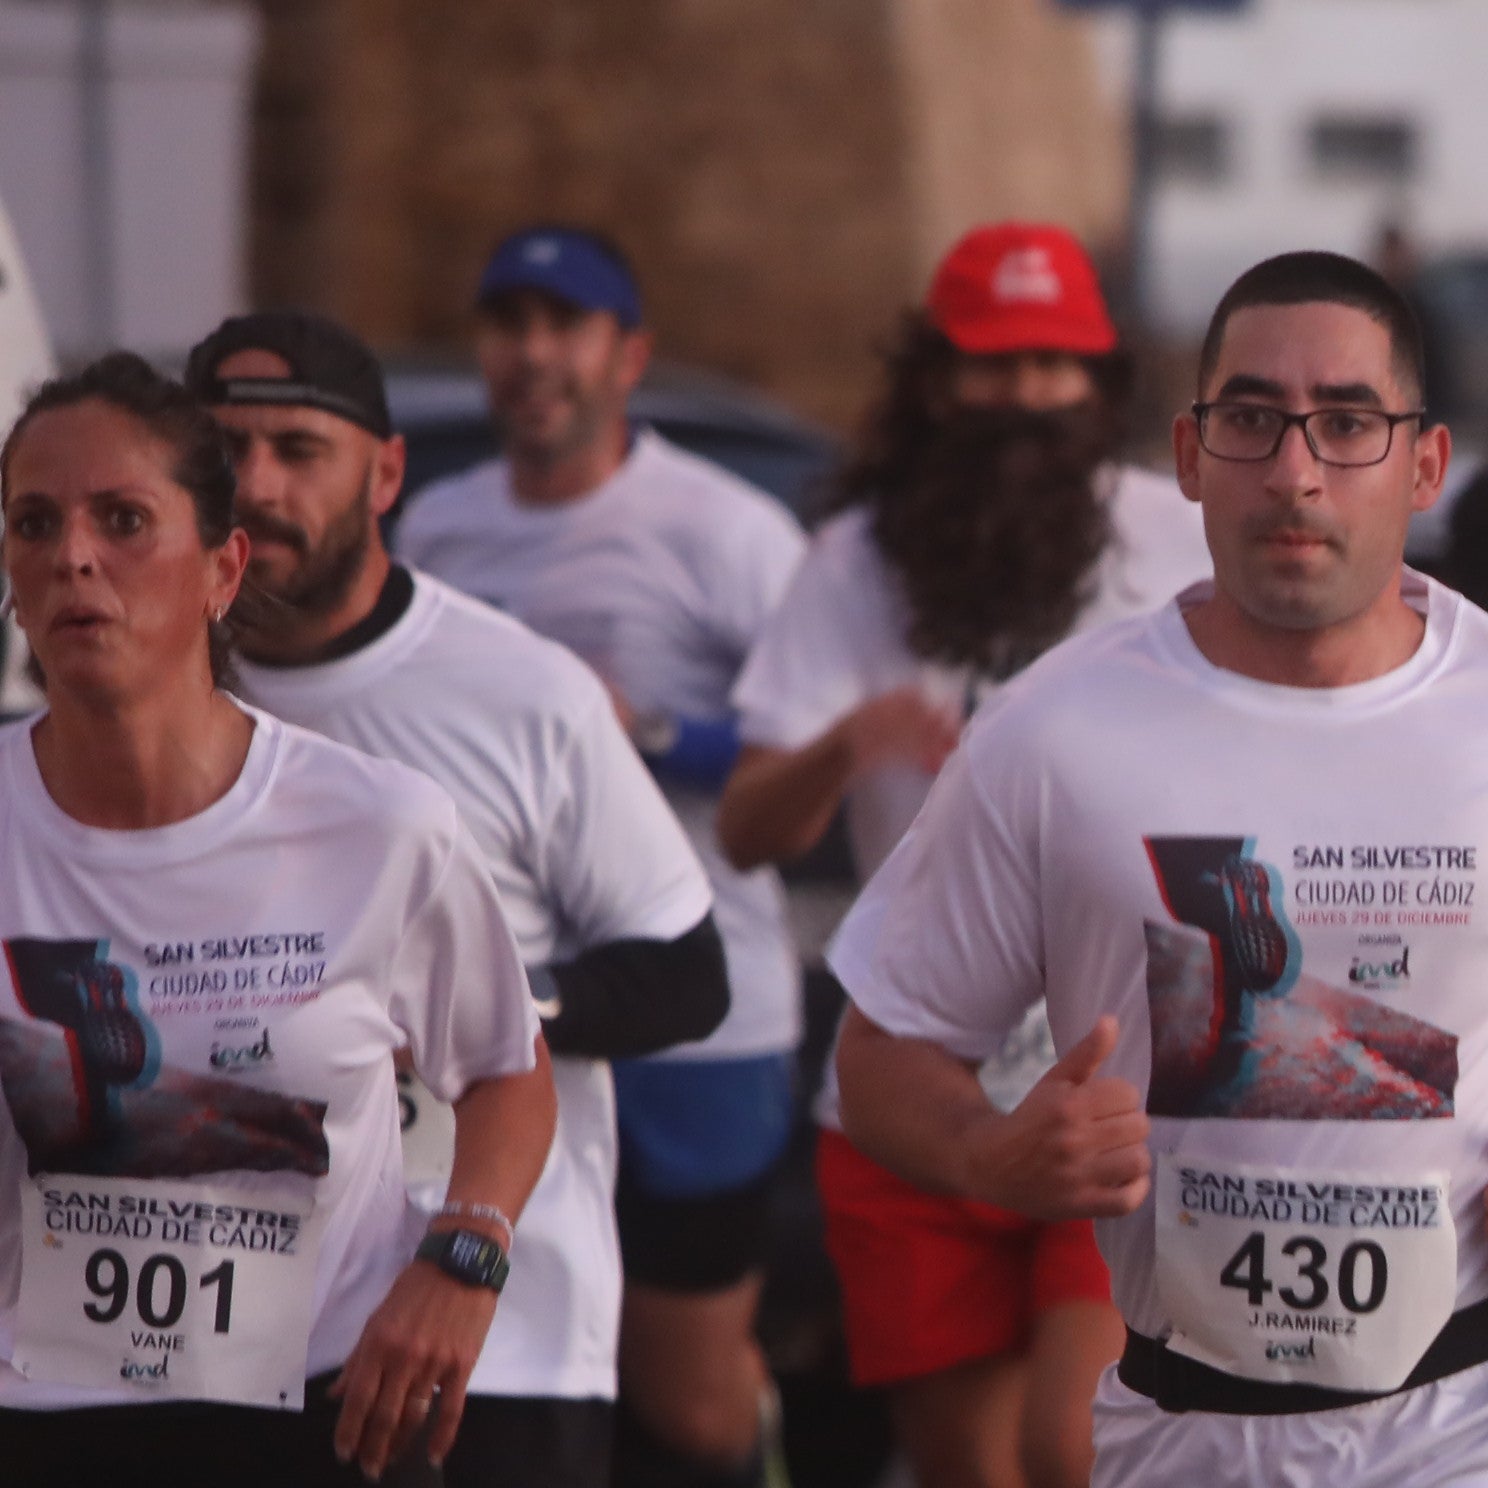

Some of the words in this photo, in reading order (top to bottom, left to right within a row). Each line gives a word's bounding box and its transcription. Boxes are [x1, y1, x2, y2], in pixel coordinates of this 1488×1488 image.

[1293, 845, 1343, 869] SAN
[1351, 845, 1476, 869] SILVESTRE
[1295, 879, 1375, 905] CIUDAD
[1383, 880, 1408, 904] DE
[1416, 875, 1475, 906] CÁDIZ
[1297, 911, 1346, 925] JUEVES
[1352, 911, 1370, 925] 29
[1374, 911, 1391, 925] DE
[144, 941, 194, 968] SAN
[201, 932, 325, 962] SILVESTRE
[150, 969, 228, 998] CIUDAD
[234, 966, 261, 991] DE
[1180, 1167, 1245, 1194] SAN
[1255, 1180, 1438, 1203] SILVESTRE
[44, 1190, 111, 1212] SAN
[118, 1195, 301, 1231] SILVESTRE
[1182, 1185, 1292, 1222] CIUDAD
[1302, 1200, 1340, 1226] DE
[46, 1208, 152, 1239] CIUDAD
[162, 1219, 201, 1244] DE
[1219, 1231, 1389, 1314] 430
[83, 1247, 236, 1336] 901
[130, 1330, 186, 1352] VANE
